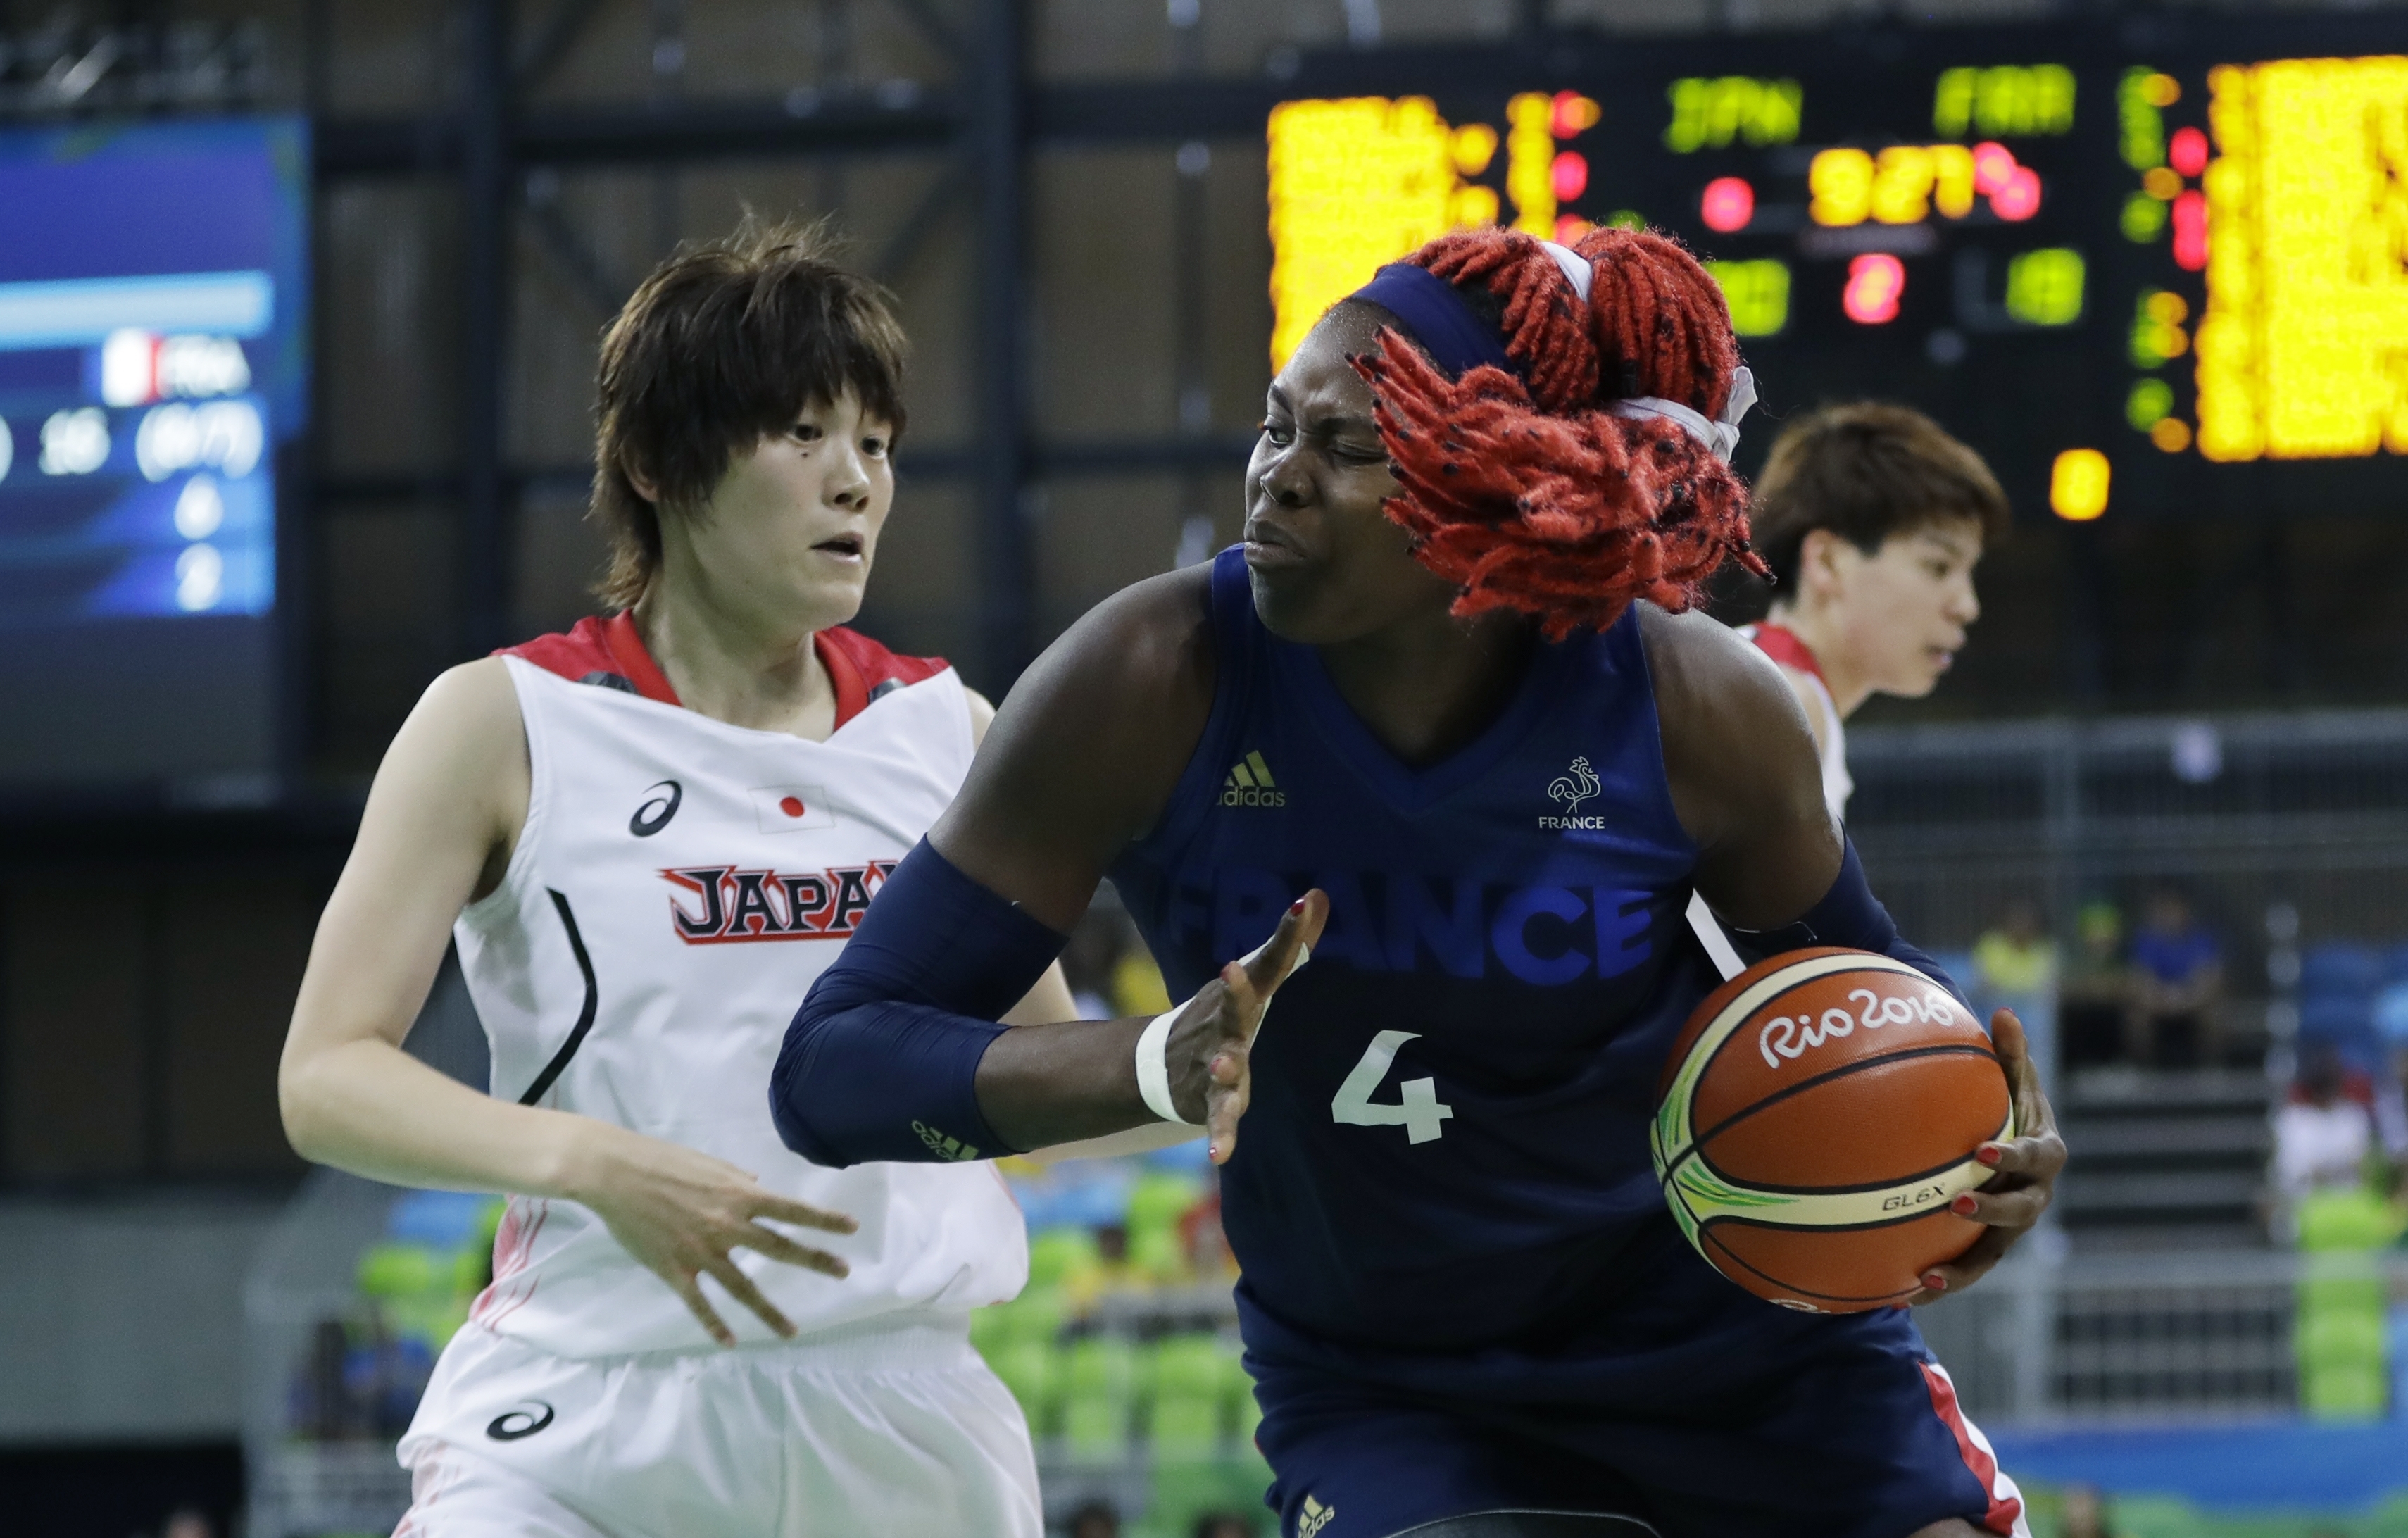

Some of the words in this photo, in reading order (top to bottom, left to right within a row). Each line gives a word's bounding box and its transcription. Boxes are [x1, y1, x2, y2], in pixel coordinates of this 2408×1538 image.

[1538, 816, 1605, 830] FRANCE
[656, 860, 899, 946] JAPA
[1167, 868, 1654, 986] FRANCE
[1760, 1008, 1855, 1069] Rio
[1848, 988, 1955, 1029] 2016
[1331, 1029, 1454, 1145] 4
[1883, 1182, 1945, 1211] GL6X
